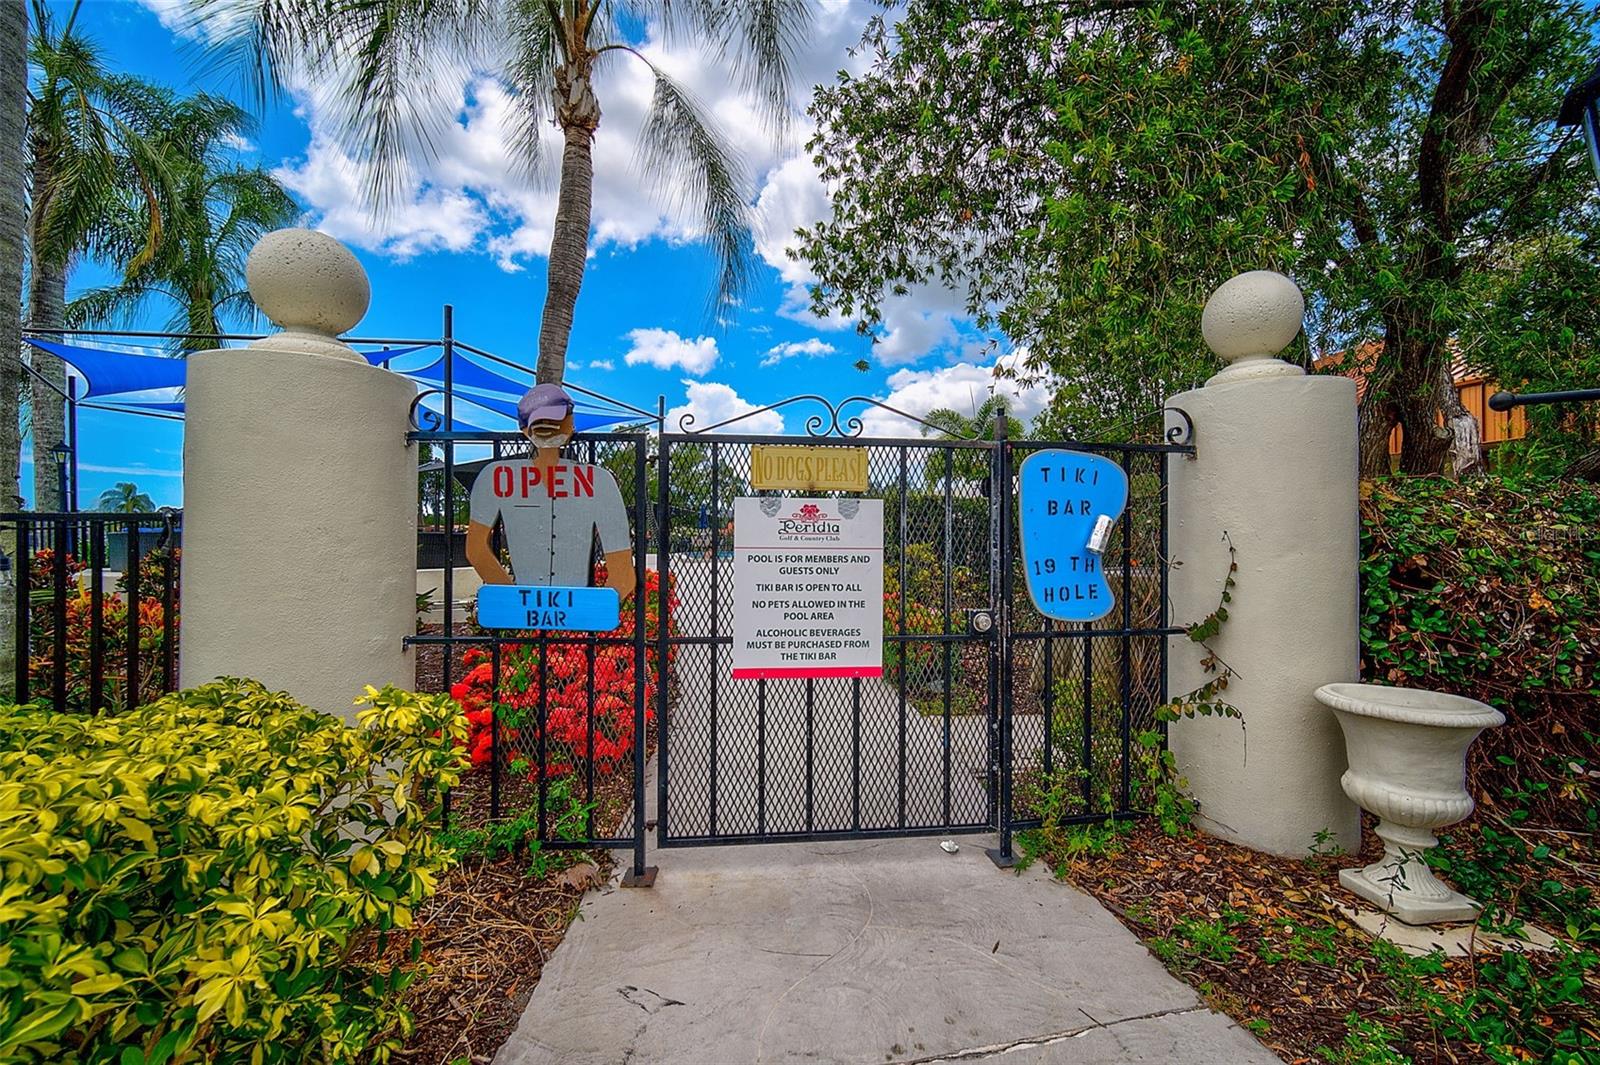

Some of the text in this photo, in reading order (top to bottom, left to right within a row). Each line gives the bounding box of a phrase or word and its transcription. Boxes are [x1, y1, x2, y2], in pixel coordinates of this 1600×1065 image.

[755, 450, 865, 486] NO DOGS PLEASE
[493, 465, 594, 498] OPEN
[1040, 467, 1098, 485] TIKI
[1048, 500, 1091, 515] BAR
[778, 519, 840, 534] Peridia
[748, 555, 870, 563] POOL IS FOR MEMBERS AND
[1034, 556, 1095, 576] 19 TH
[779, 567, 839, 575] GUESTS ONLY
[756, 583, 862, 591] TIKI BAR IS OPEN TO ALL
[1044, 584, 1098, 602] HOLE
[518, 589, 573, 608] TIKI
[752, 600, 865, 608] NO PETS ALLOWED IN THE
[527, 610, 567, 627] BAR
[784, 612, 834, 620] POOL AREA
[756, 628, 861, 637] ALCOHOLIC BEVERAGES
[747, 640, 869, 649] MUST BE PURCHASED FROM
[781, 652, 836, 660] THE TIKI BAR
